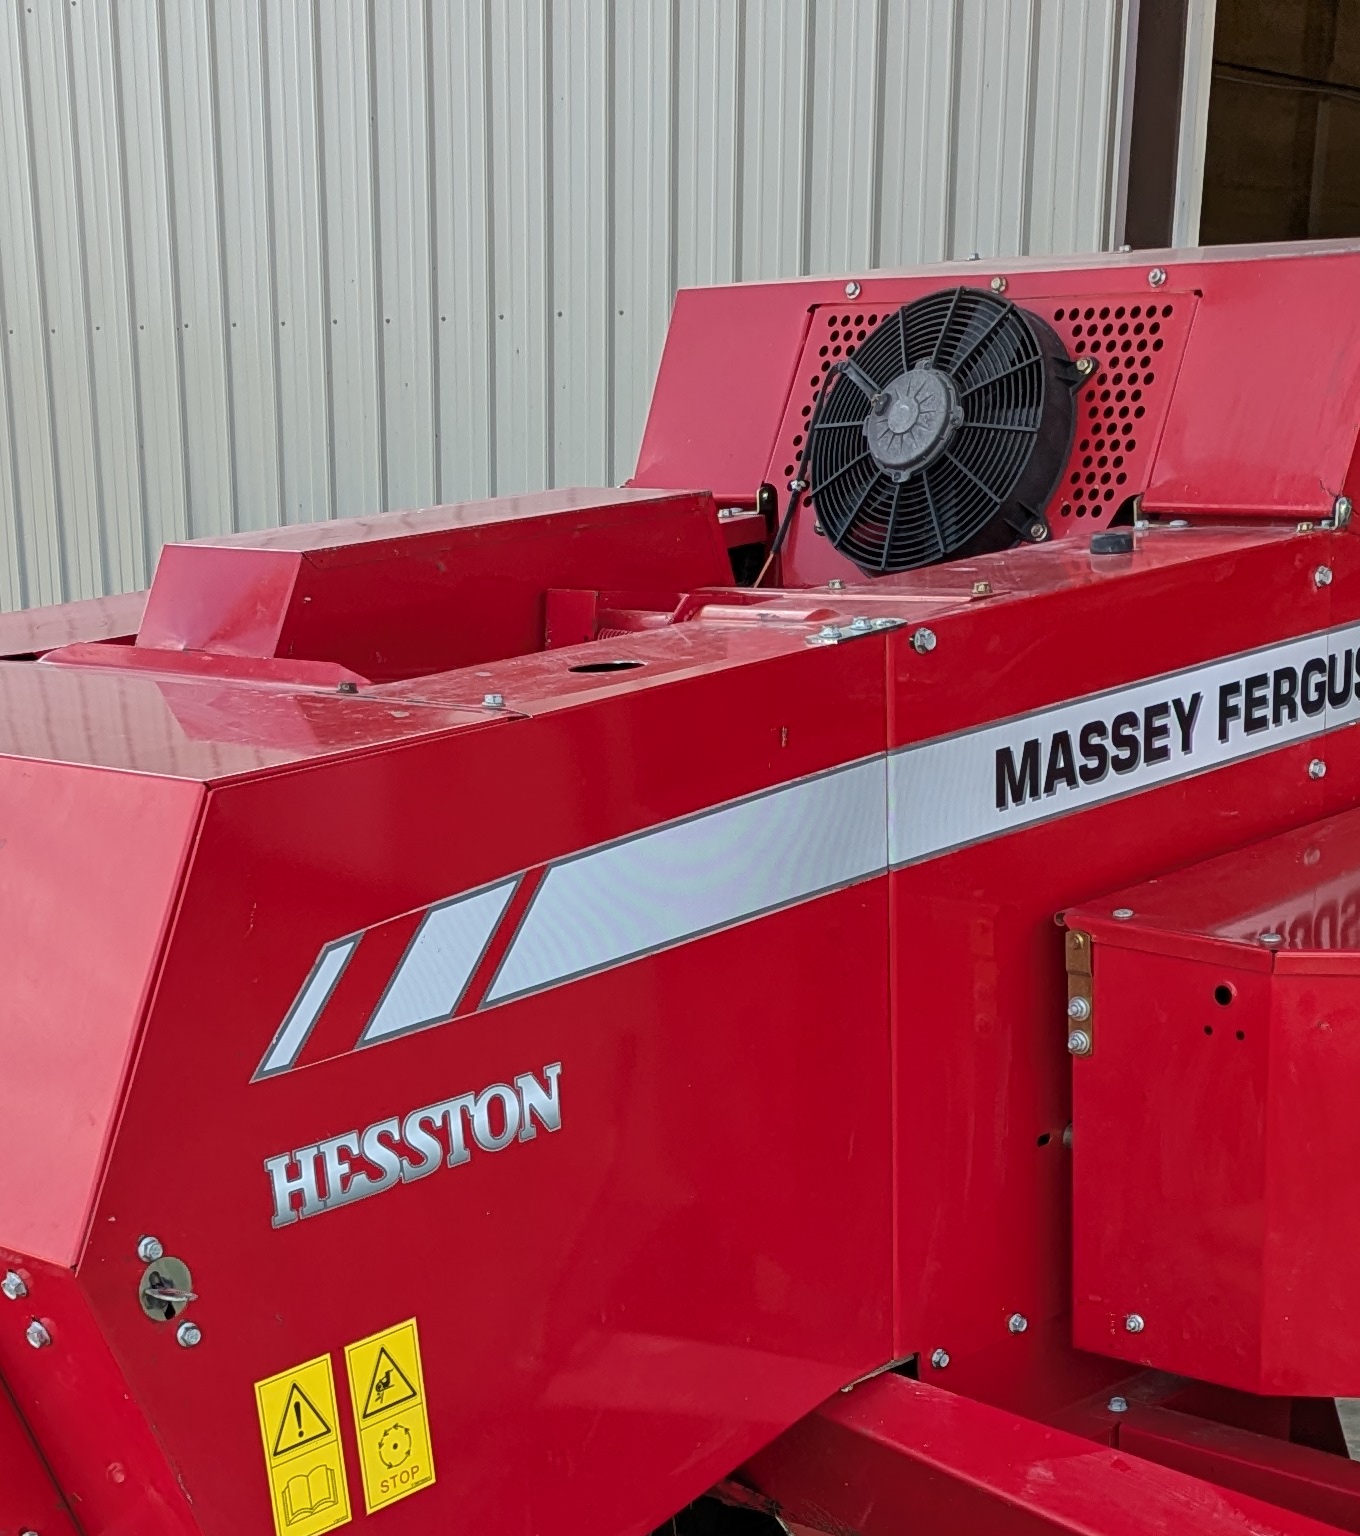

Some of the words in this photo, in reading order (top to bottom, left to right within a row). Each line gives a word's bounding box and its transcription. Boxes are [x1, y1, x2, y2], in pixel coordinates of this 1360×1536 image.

[995, 691, 1202, 813] MASSEY
[264, 1062, 562, 1229] HESSTON
[380, 1465, 420, 1494] STOP
